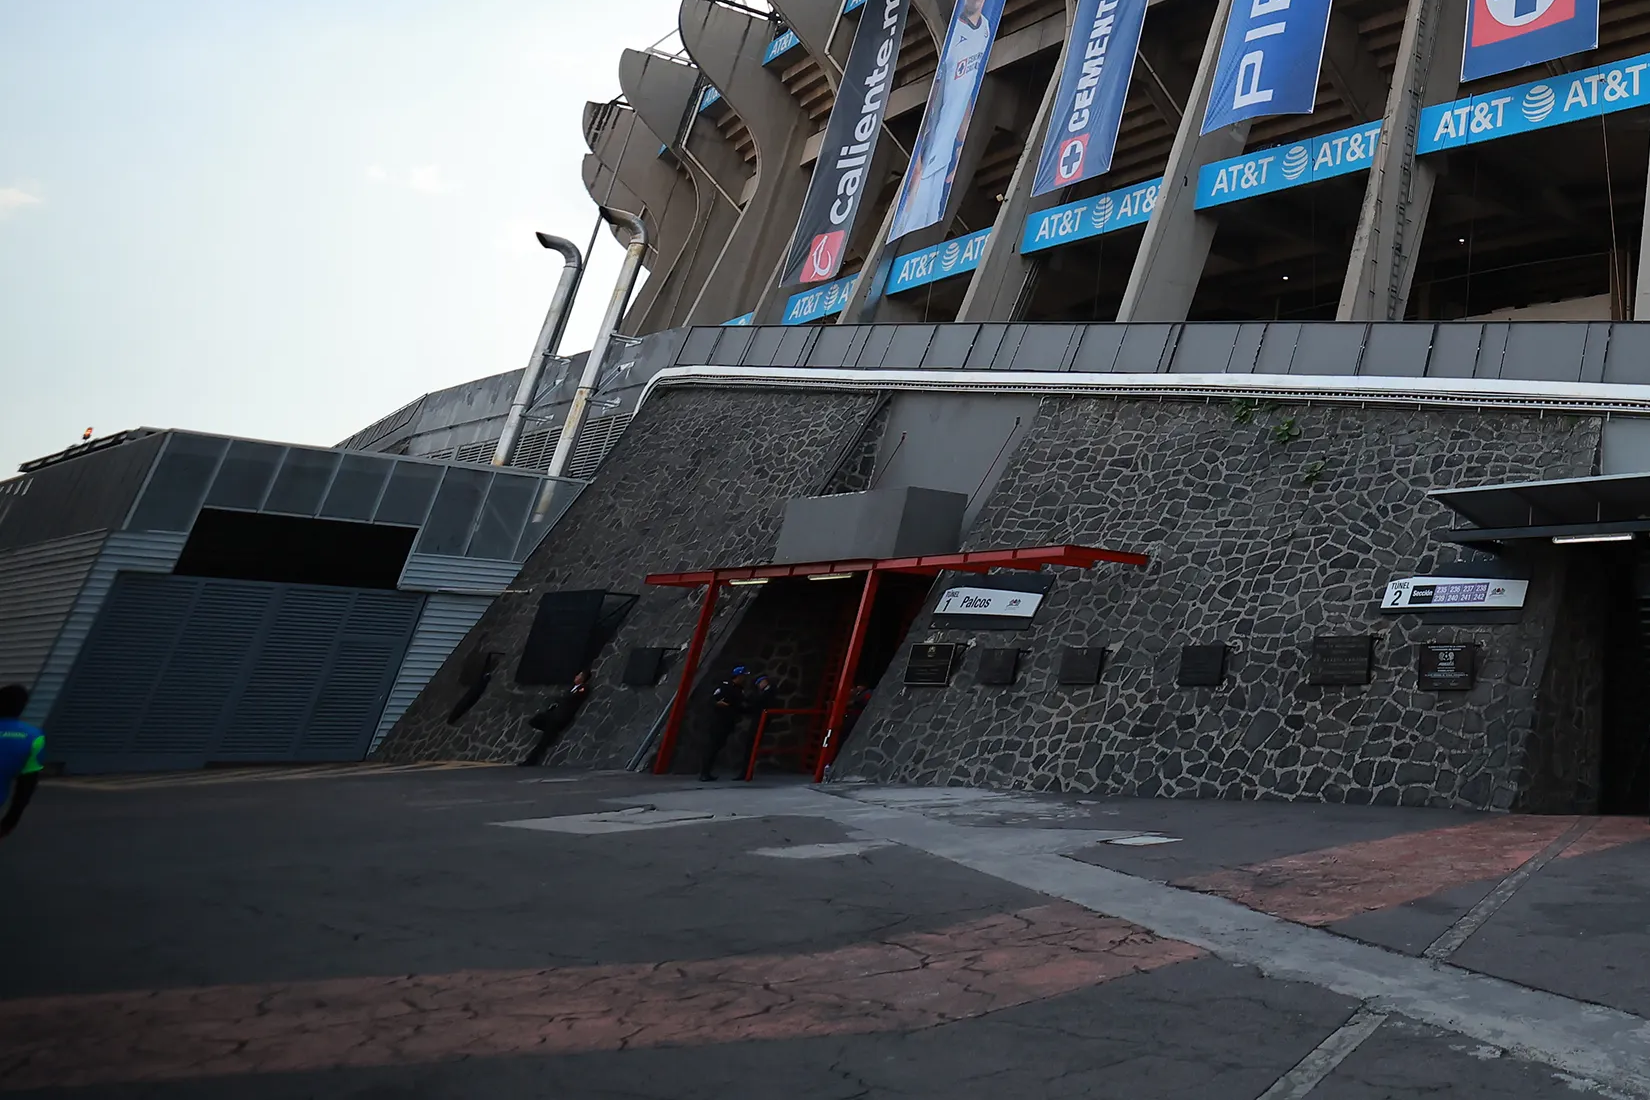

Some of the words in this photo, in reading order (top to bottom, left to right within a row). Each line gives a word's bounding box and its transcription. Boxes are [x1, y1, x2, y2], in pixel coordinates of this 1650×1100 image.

[1434, 97, 1511, 141] AT&T
[1565, 64, 1643, 111] AT&T
[1211, 155, 1275, 197] AT&T
[1035, 206, 1087, 242] AT&T
[1117, 189, 1159, 226] AT&
[897, 251, 940, 284] AT&T
[789, 290, 823, 321] AT&T
[1391, 590, 1402, 606] 2
[1447, 594, 1459, 602] 240
[1472, 593, 1485, 601] 242
[1463, 584, 1474, 592] 237
[943, 598, 952, 611] 1
[960, 596, 991, 608] Palcos
